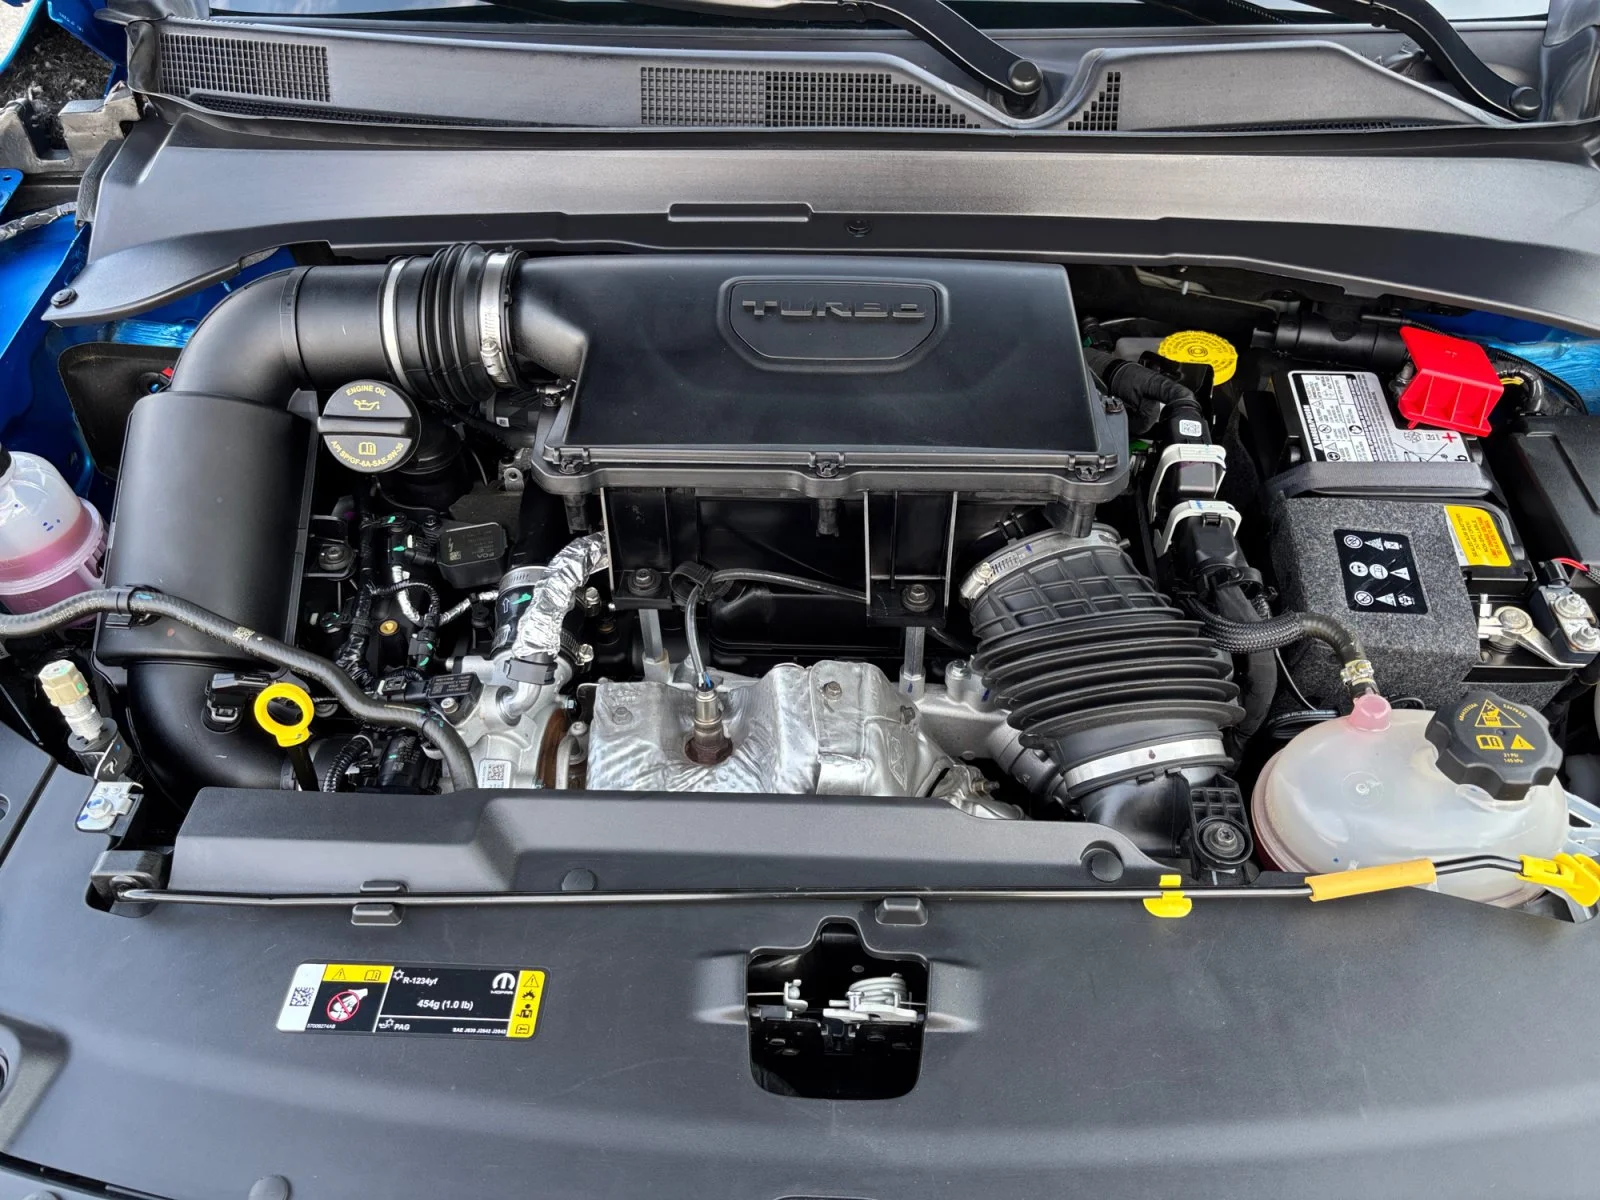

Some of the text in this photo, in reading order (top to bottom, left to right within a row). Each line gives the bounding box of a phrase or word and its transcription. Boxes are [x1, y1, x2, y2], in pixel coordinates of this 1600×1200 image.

[742, 299, 926, 319] TURBO
[346, 384, 387, 397] ENGINE OIL
[402, 976, 439, 987] R-1234yf
[416, 999, 475, 1012] 454g (1.0 lb)
[394, 1023, 411, 1031] PAG
